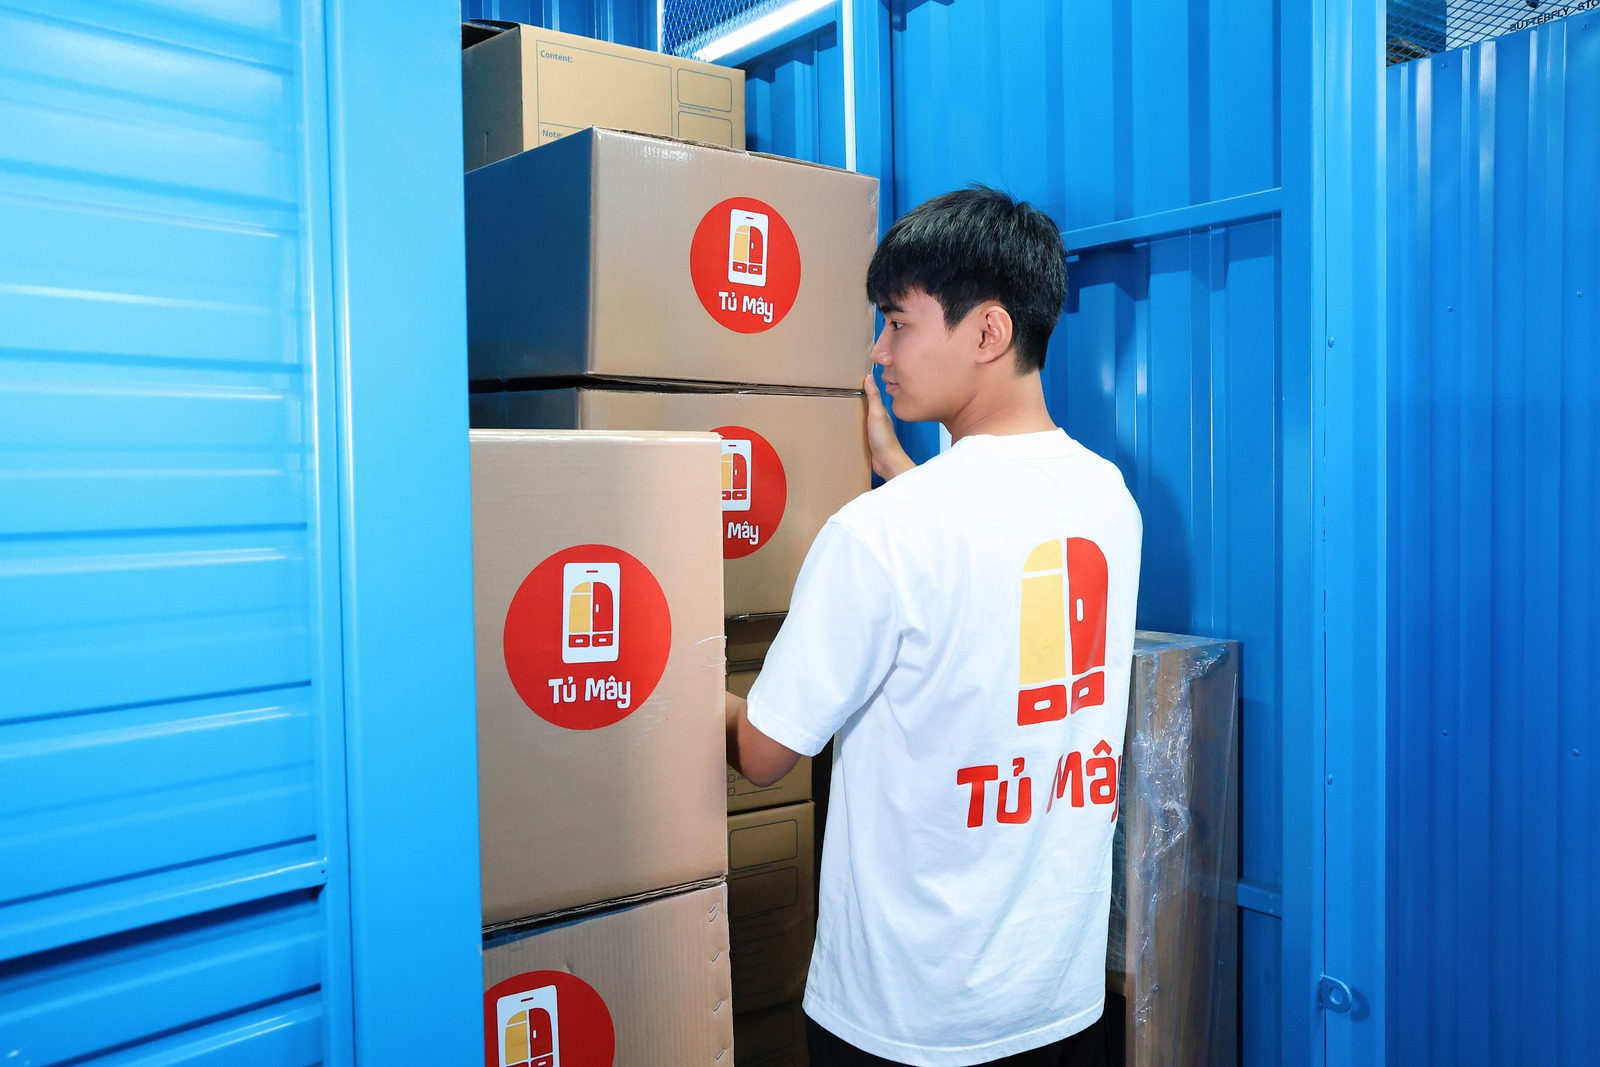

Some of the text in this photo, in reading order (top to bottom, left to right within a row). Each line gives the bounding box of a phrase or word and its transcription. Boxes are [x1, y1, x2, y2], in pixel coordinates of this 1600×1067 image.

[540, 50, 573, 63] Content:
[718, 291, 774, 323] Tủ Mây
[727, 520, 759, 545] Mây
[548, 675, 631, 709] Tủ Mây
[957, 757, 1032, 828] Tủ
